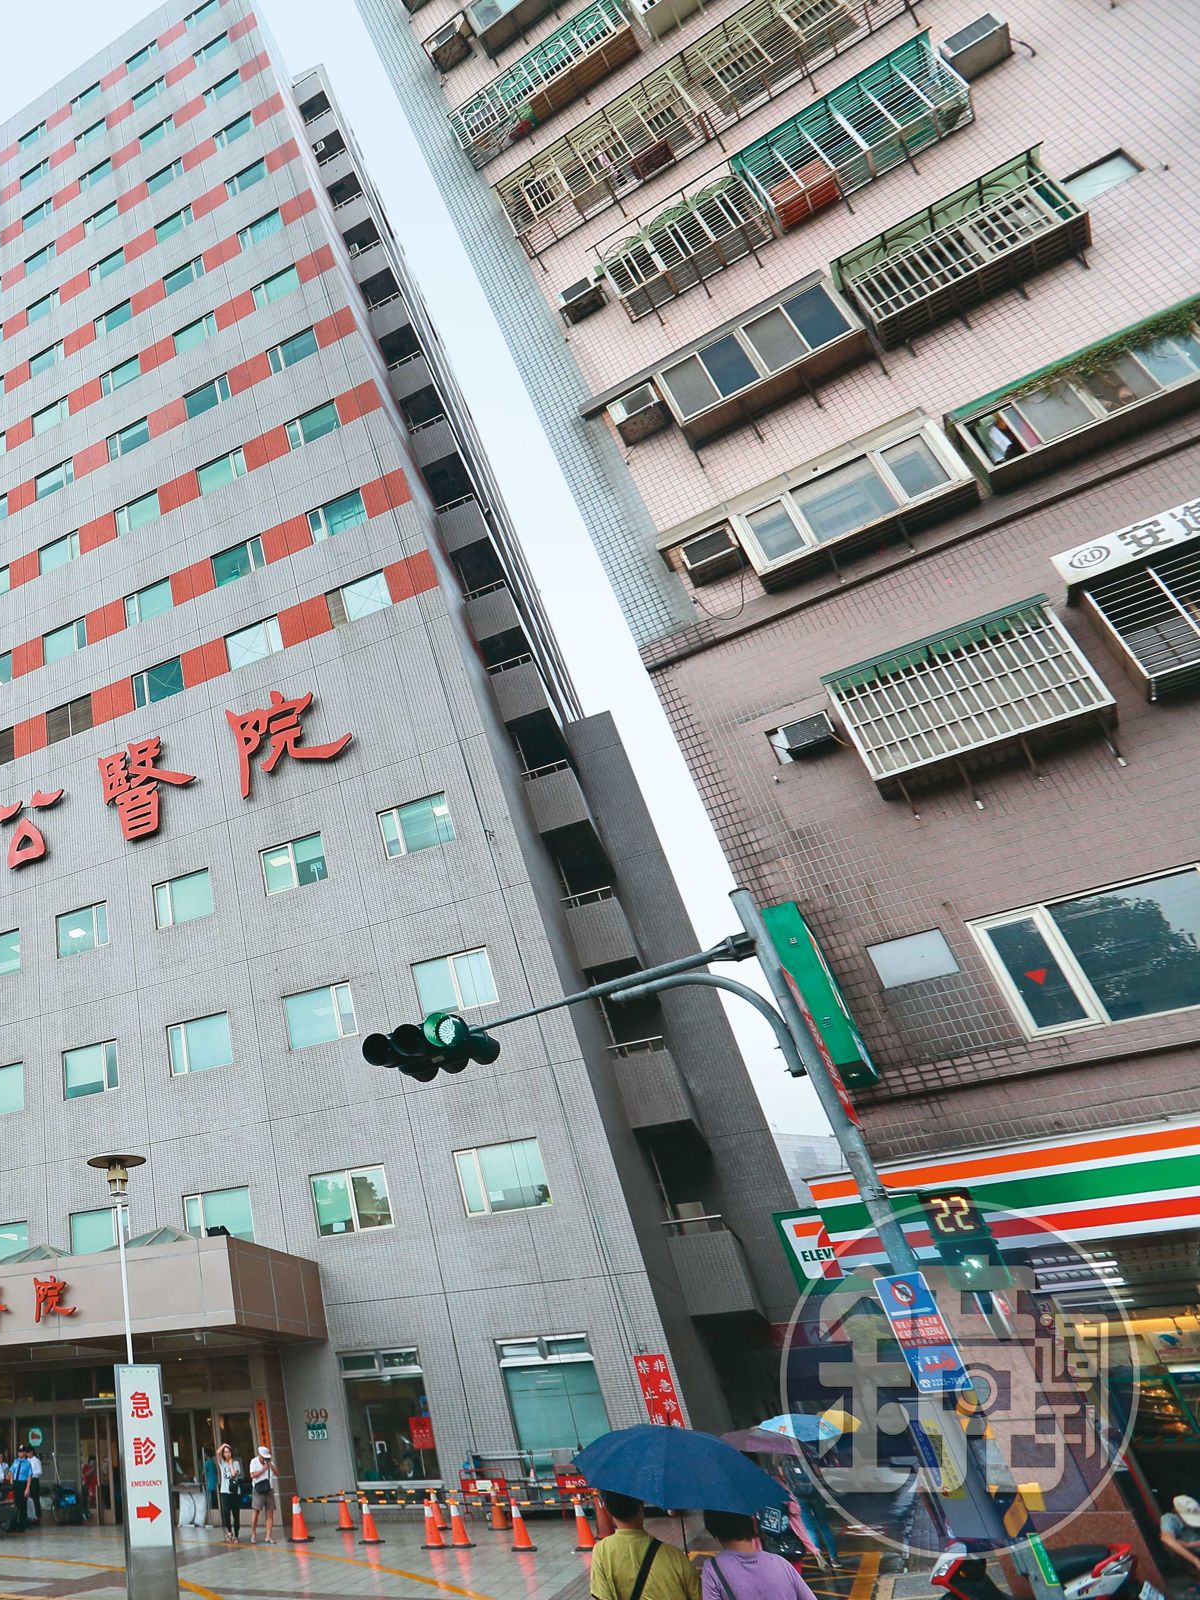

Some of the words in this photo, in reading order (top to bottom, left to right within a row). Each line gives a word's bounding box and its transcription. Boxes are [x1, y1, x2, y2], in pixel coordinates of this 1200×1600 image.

[931, 1196, 975, 1233] 22
[801, 1247, 834, 1262] ELEV
[304, 1408, 328, 1425] 399
[130, 1390, 157, 1467] 急診
[310, 1431, 326, 1440] 399
[130, 1479, 163, 1488] EMERGENCY
